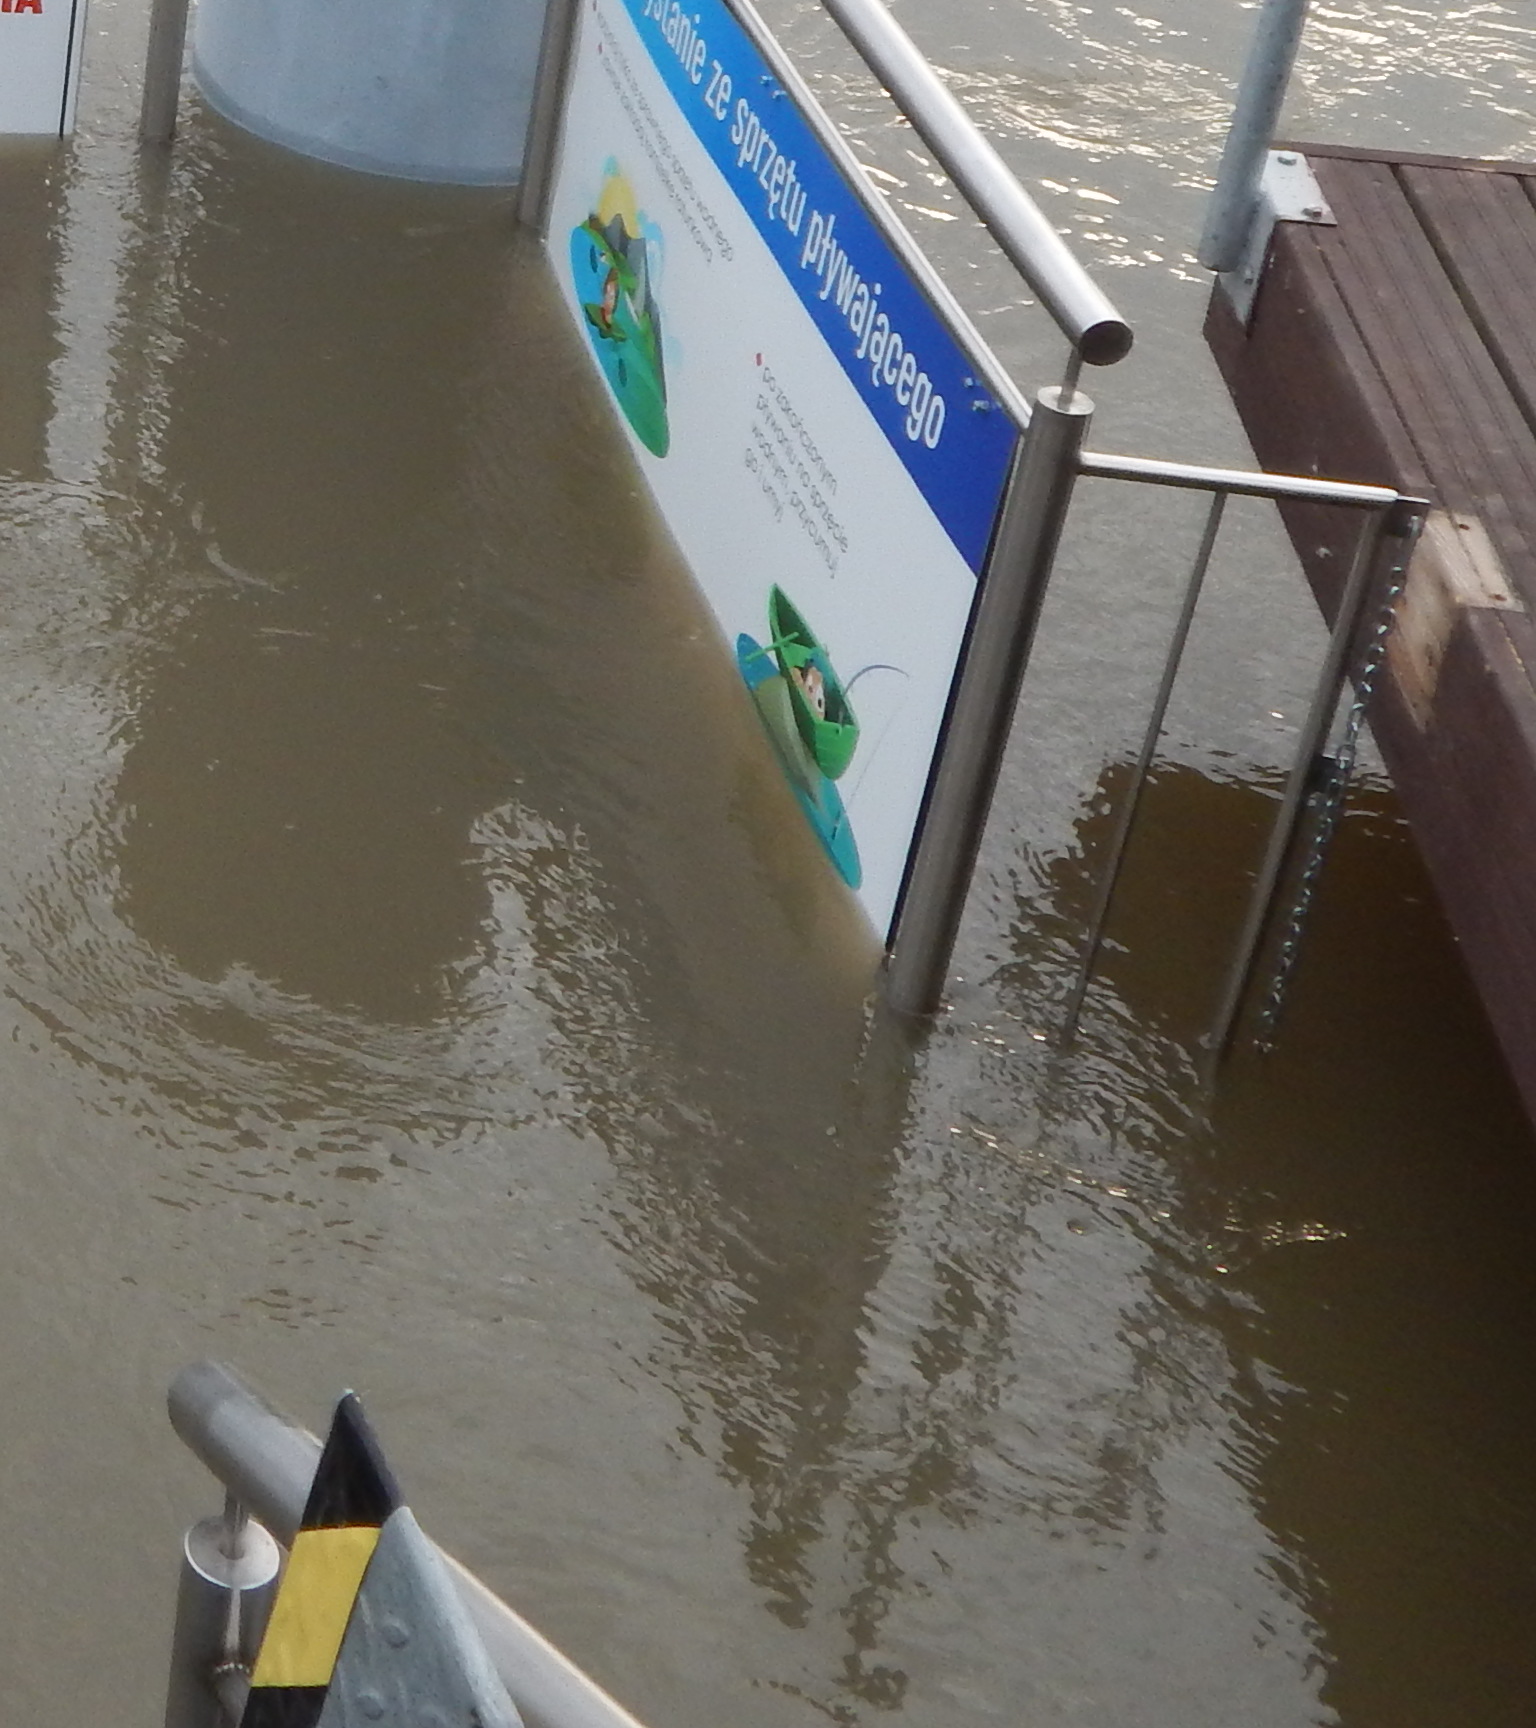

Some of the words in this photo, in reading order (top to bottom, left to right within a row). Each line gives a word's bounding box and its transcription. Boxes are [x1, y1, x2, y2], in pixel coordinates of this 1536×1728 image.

[704, 59, 731, 120] ze
[731, 97, 806, 235] sprzętu
[800, 209, 945, 448] pływającego
